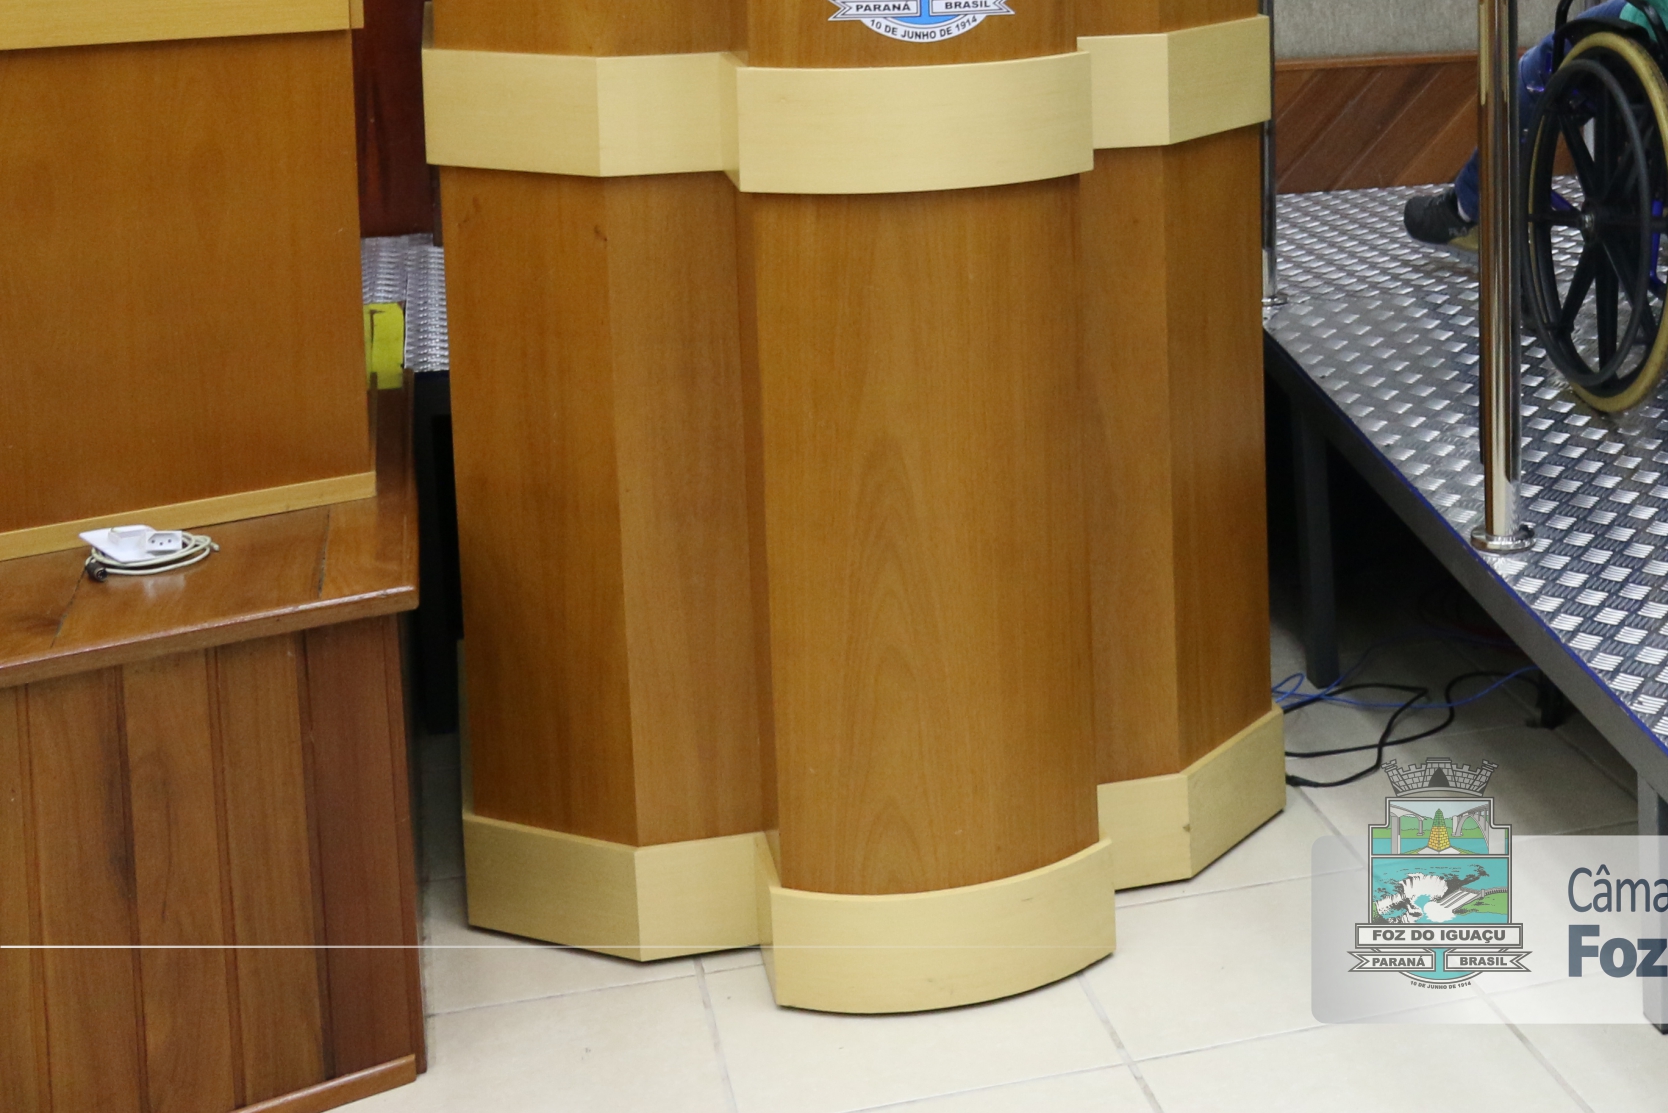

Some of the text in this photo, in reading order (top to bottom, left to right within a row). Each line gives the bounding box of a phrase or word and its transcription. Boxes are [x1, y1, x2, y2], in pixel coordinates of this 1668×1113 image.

[855, 0, 991, 12] PARANÁ BRASIL
[870, 15, 978, 40] 10 DE JUNHO DE 1914
